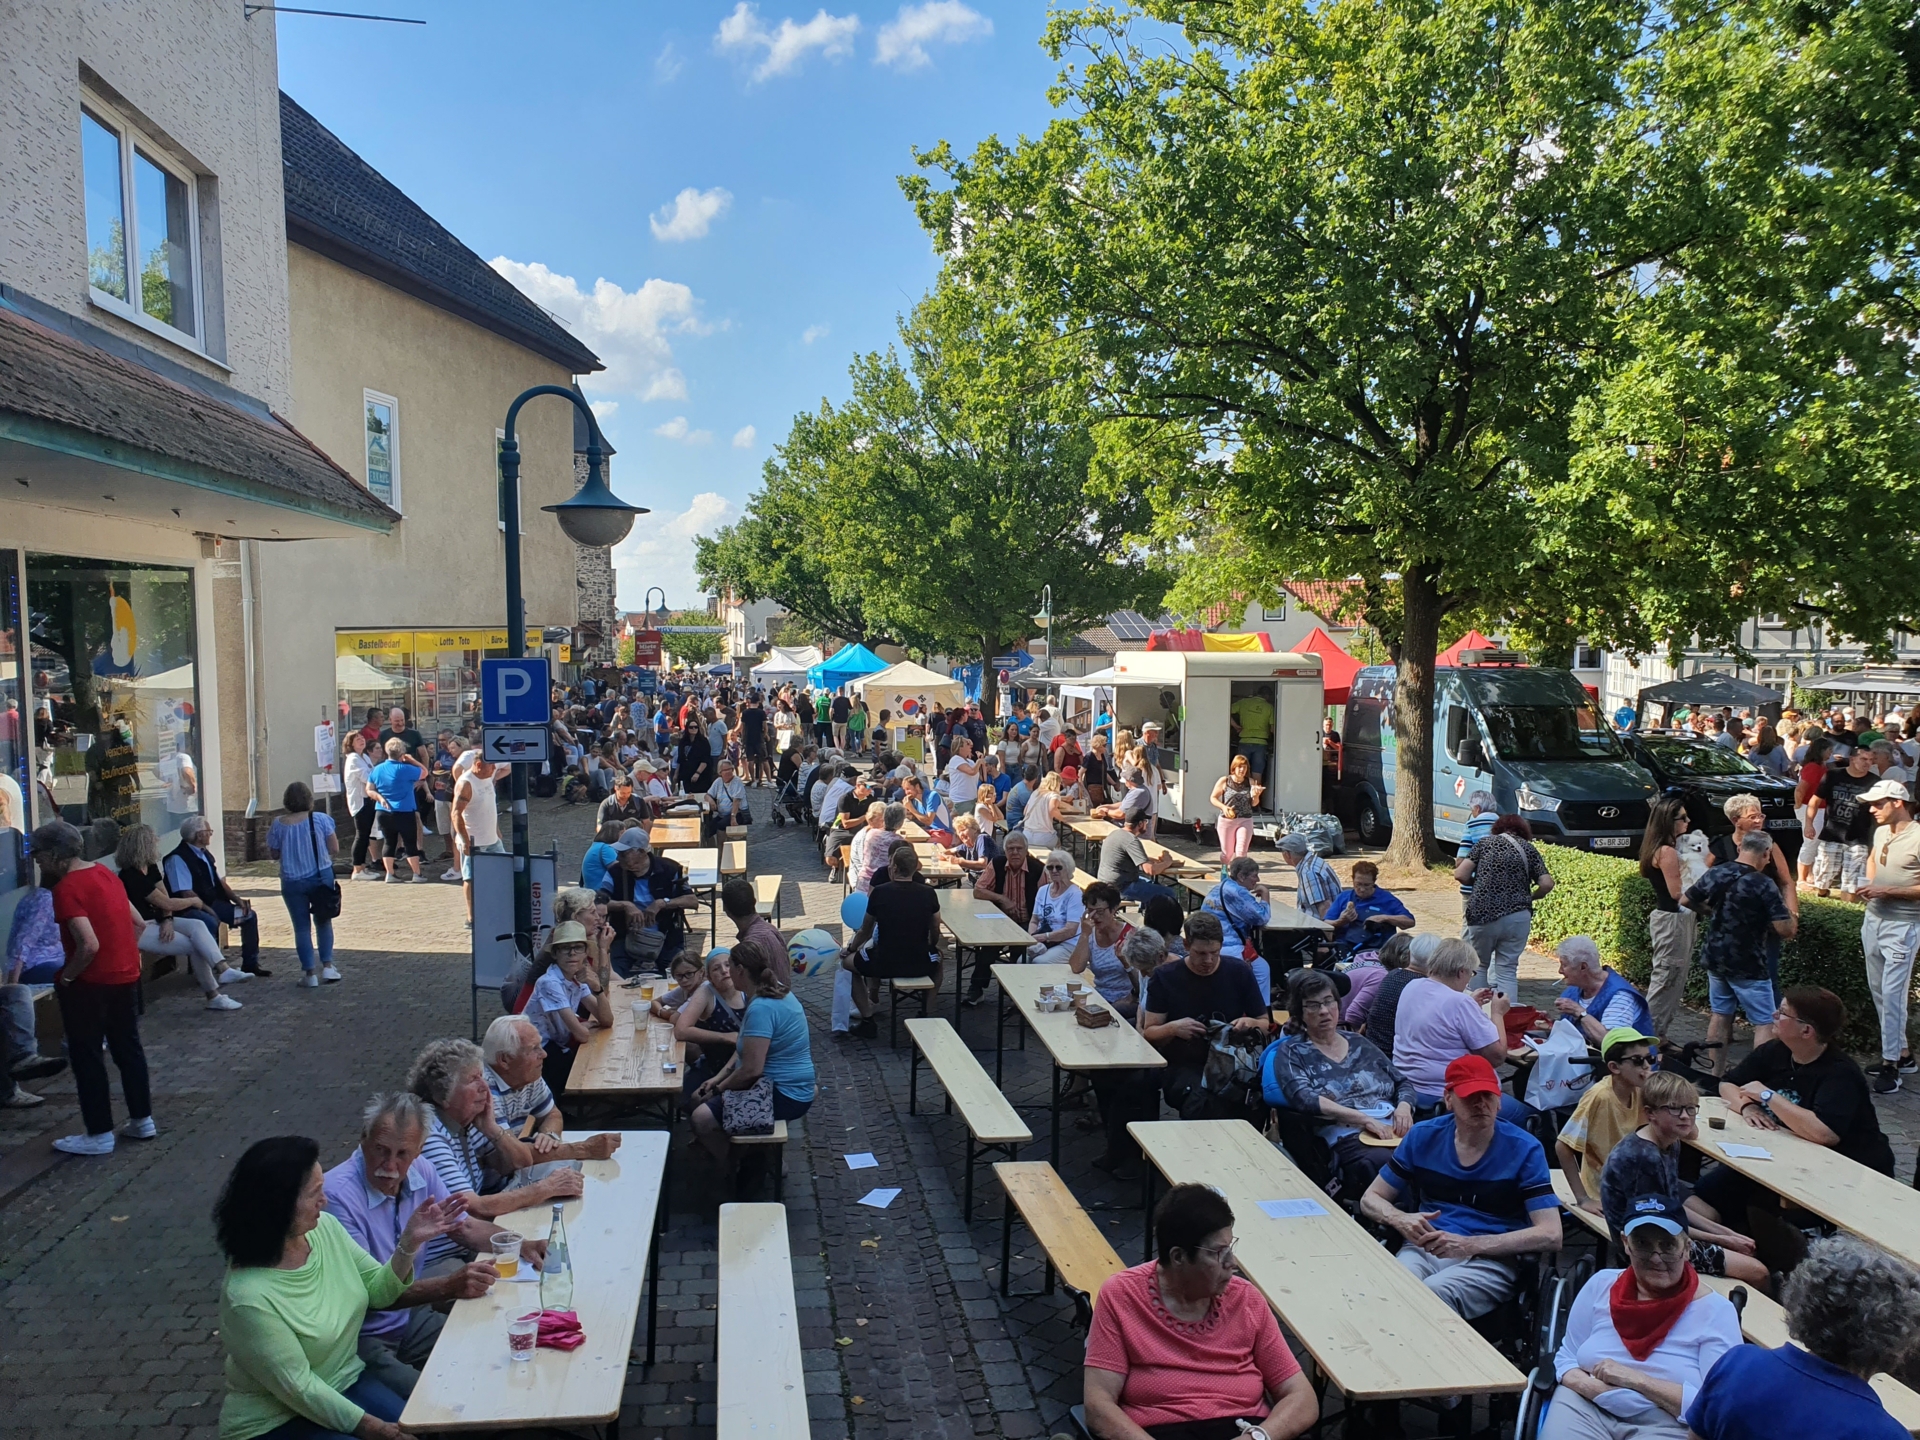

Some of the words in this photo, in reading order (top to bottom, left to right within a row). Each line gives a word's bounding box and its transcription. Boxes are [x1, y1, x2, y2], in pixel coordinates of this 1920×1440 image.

[358, 638, 401, 649] Bastelbedarf
[439, 636, 454, 646] Lotto
[458, 635, 470, 645] Toto
[497, 668, 532, 715] P
[1836, 805, 1854, 818] 66
[1594, 838, 1604, 847] KS
[1607, 838, 1617, 846] BR
[1617, 838, 1630, 846] 308
